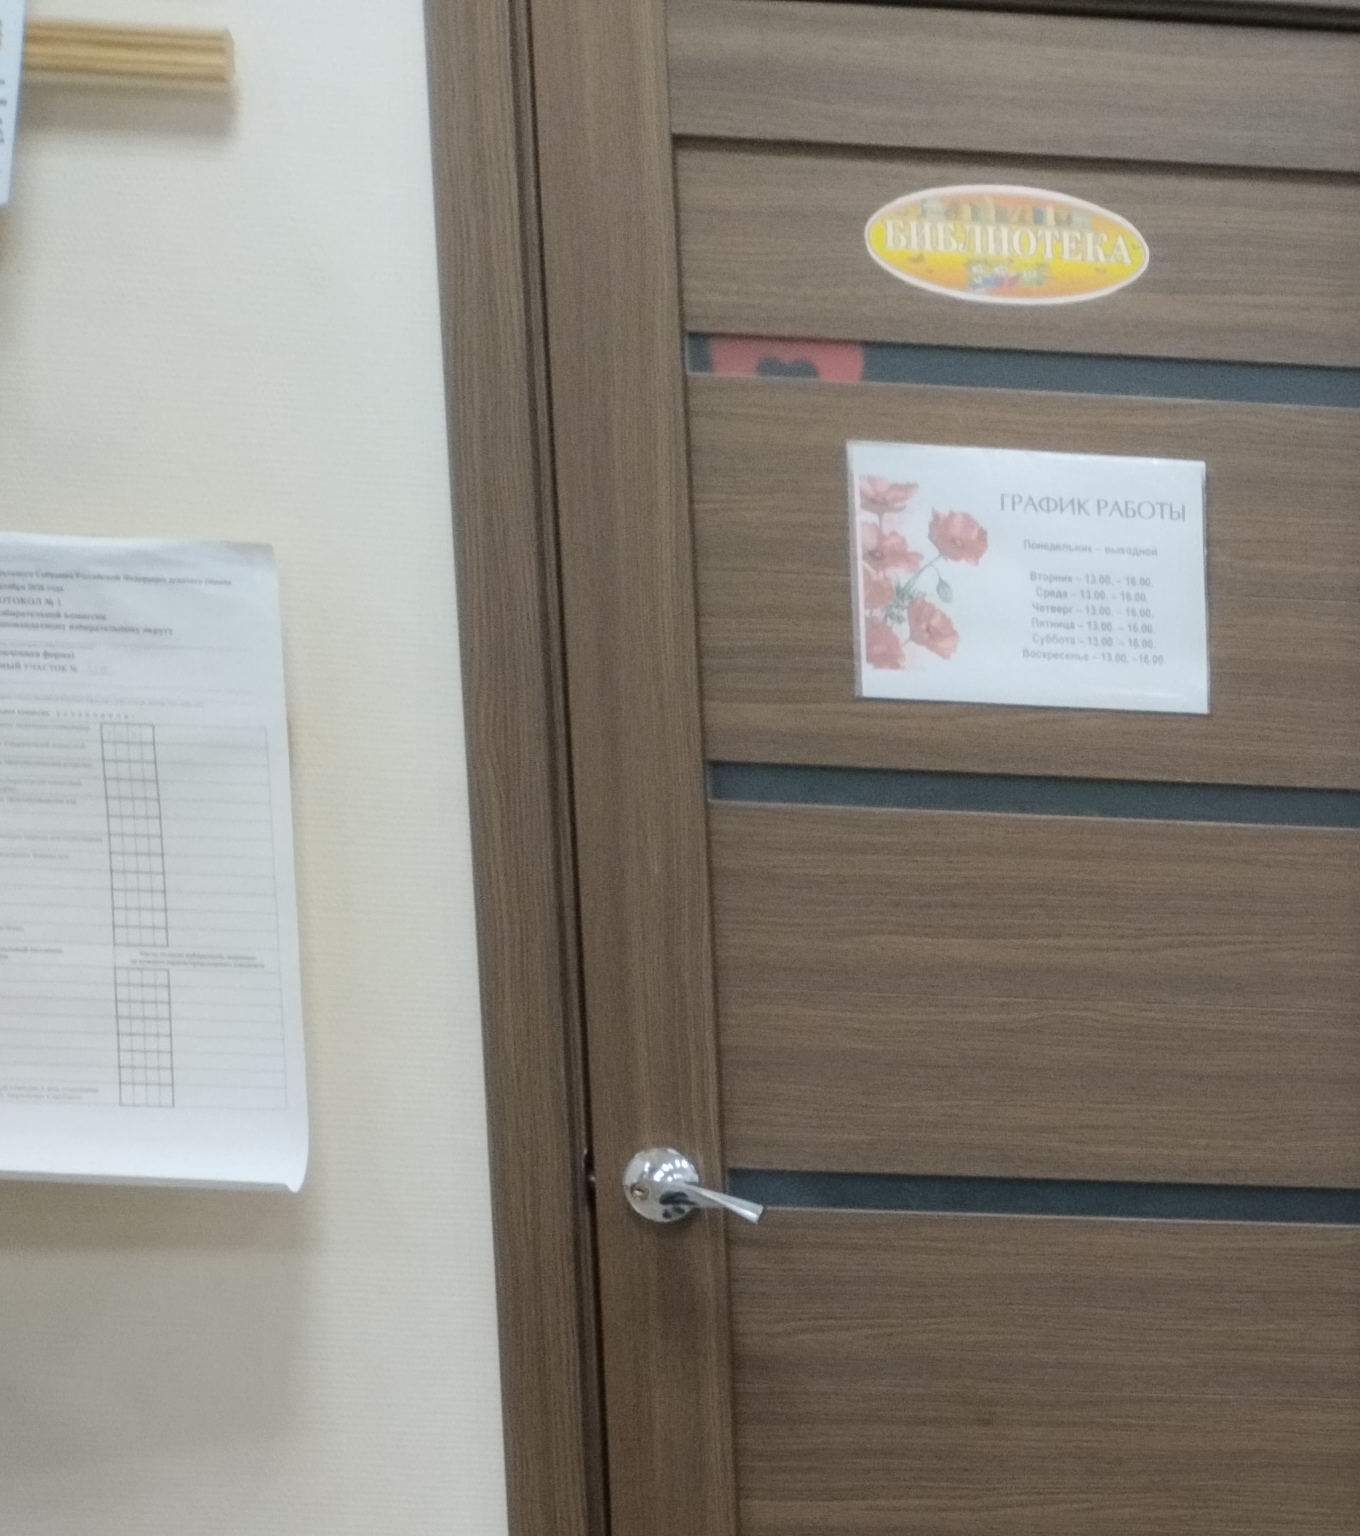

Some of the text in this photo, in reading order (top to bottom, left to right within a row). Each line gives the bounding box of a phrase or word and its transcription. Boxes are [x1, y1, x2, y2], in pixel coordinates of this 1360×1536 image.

[885, 220, 1133, 264] БИБЛИОТЕКА
[1000, 493, 1186, 522] ГРАФИК РАБОТЫ
[1023, 539, 1093, 553] Понедельник
[1104, 545, 1158, 557] выходной
[1030, 571, 1072, 584] Вторник
[1036, 586, 1068, 599] Среда
[1032, 602, 1072, 616] Четверг
[1031, 618, 1075, 630] Пятница
[1032, 634, 1076, 646] Суббота
[1022, 648, 1089, 662] Воскресенье
